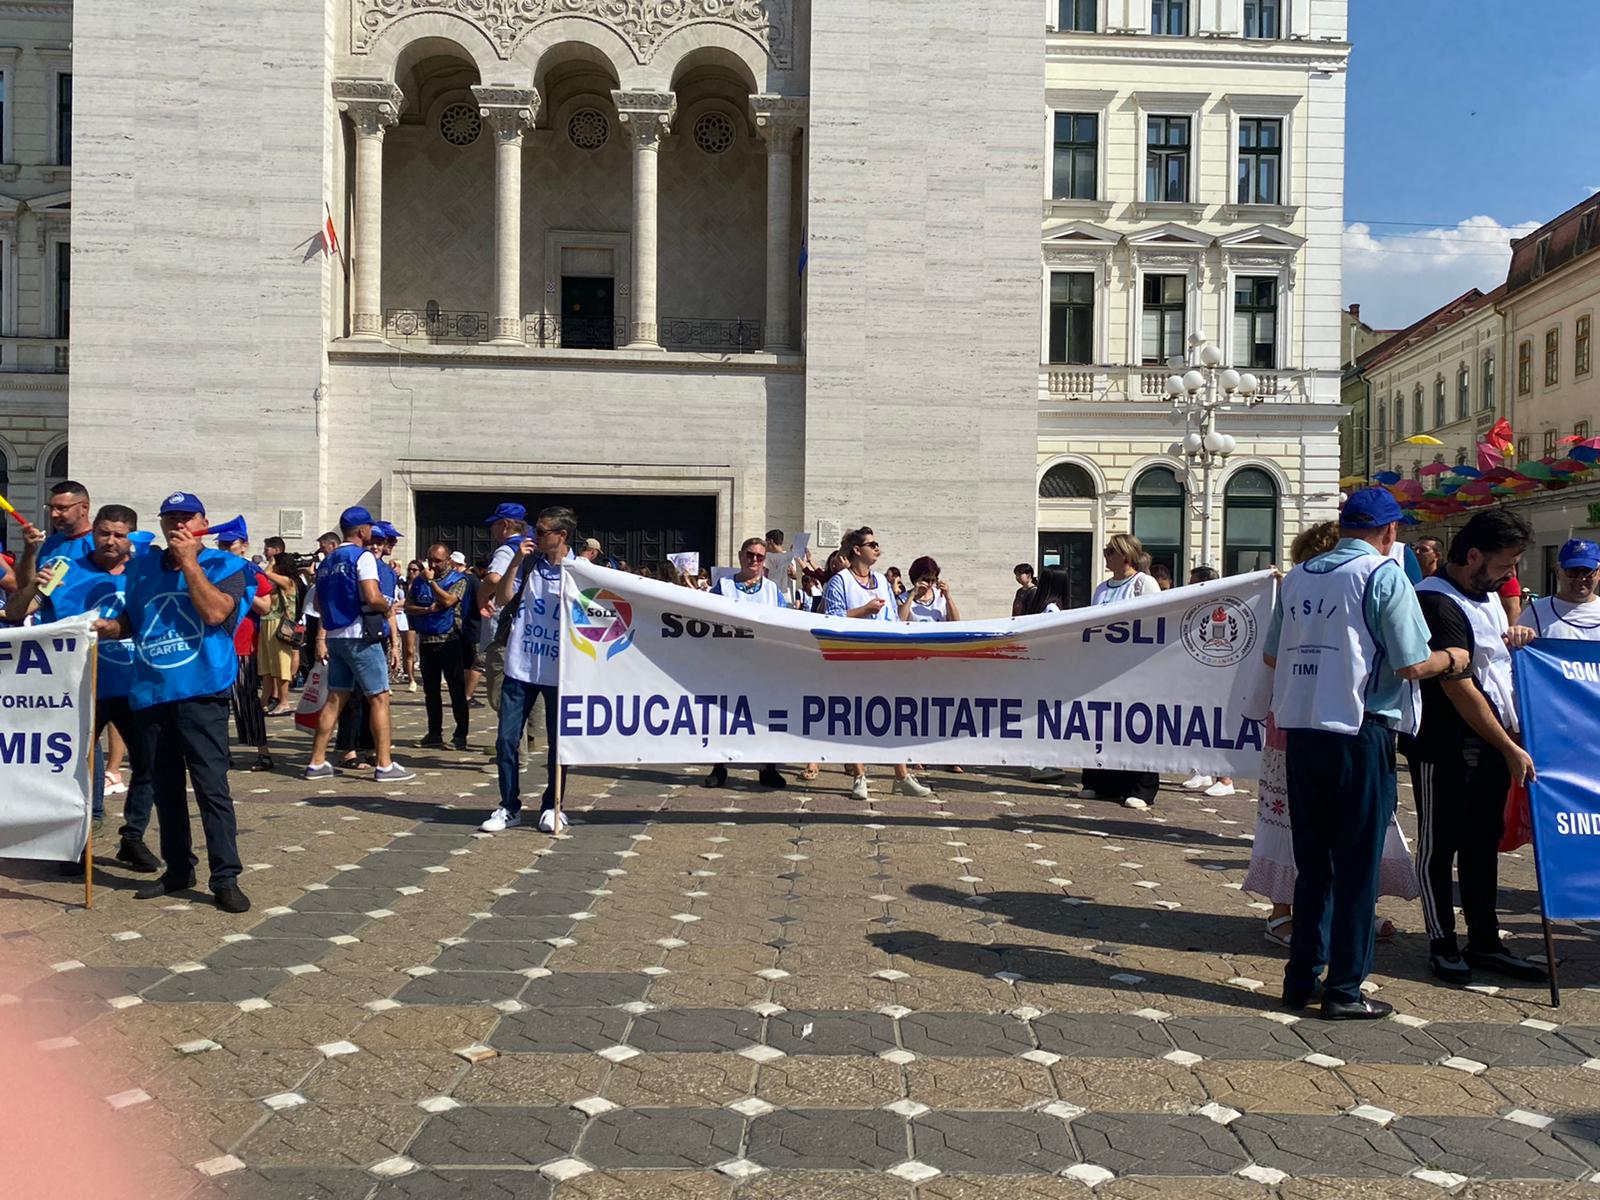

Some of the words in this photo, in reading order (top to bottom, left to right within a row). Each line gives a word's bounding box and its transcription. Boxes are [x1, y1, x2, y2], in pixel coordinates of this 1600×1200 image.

[587, 607, 617, 618] SOLE
[1082, 617, 1166, 645] FSLI
[149, 641, 191, 657] CARTEL
[1561, 660, 1600, 682] CON
[0, 691, 74, 708] ORIALĂ
[559, 695, 756, 748] EDUCAȚIA
[802, 695, 1023, 739] PRIORITATE
